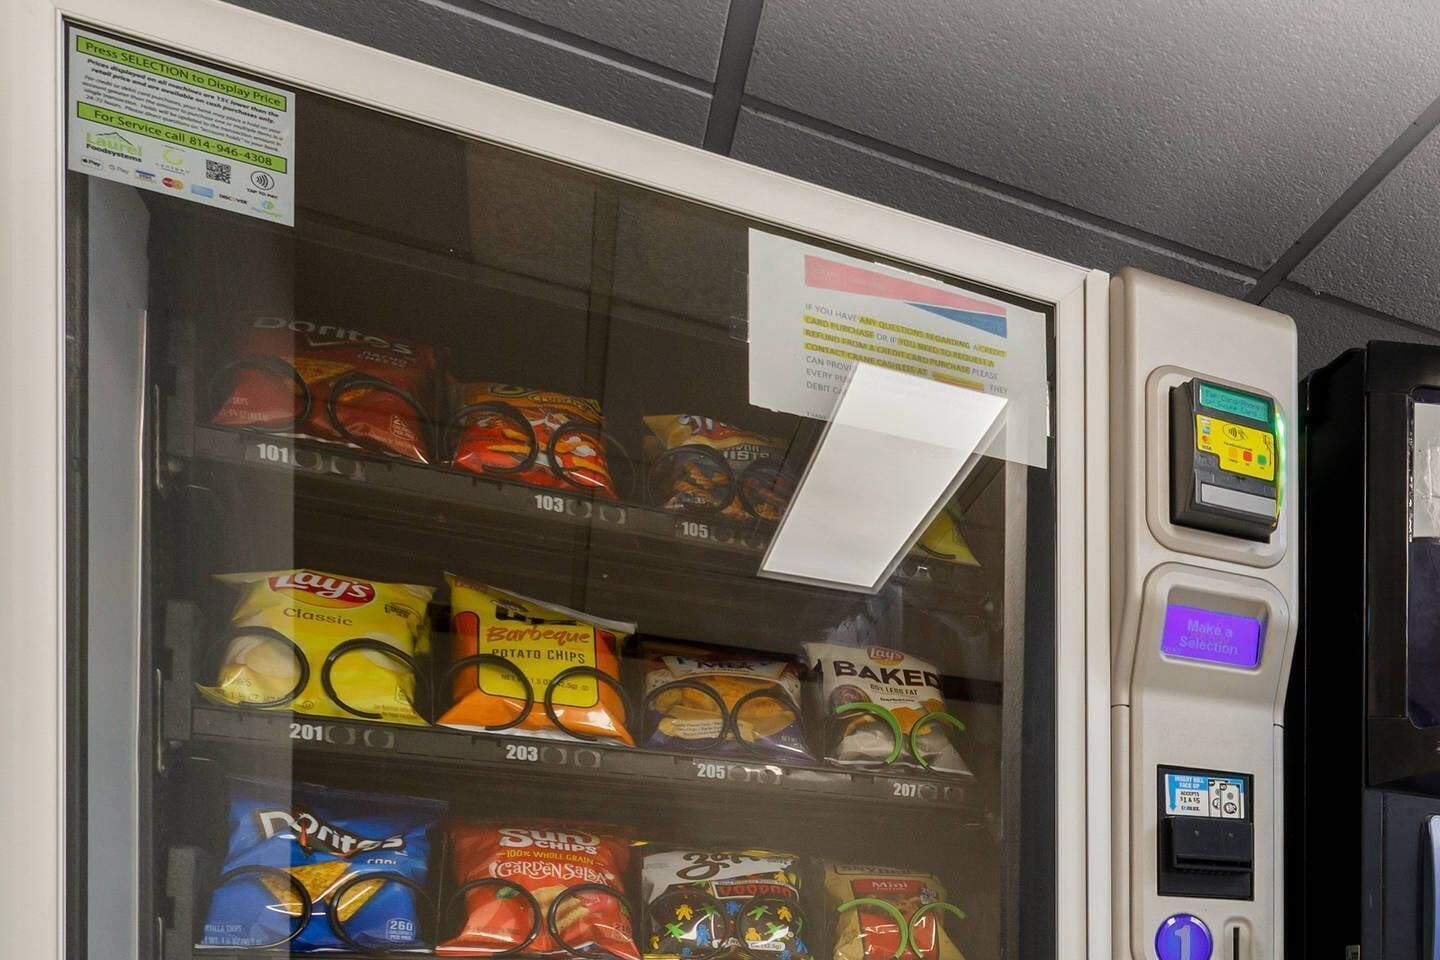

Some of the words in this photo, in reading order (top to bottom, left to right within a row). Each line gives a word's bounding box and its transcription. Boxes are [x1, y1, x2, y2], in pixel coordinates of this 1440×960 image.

[85, 41, 117, 59] Press
[121, 51, 188, 79] SELECTION
[192, 72, 203, 84] to
[207, 77, 249, 99] Display
[254, 91, 280, 106] Price
[94, 110, 113, 122] For
[117, 116, 161, 135] Service
[164, 129, 184, 141] call
[189, 136, 272, 165] 814-946-4308
[86, 144, 142, 162] Foodsystems
[253, 316, 413, 355] Doritos
[806, 355, 824, 366] CAN
[806, 368, 832, 379] EVERY
[806, 381, 829, 393] DEBIT
[256, 443, 290, 464] 101
[535, 495, 564, 513] 103
[682, 521, 708, 538] 105
[274, 571, 375, 600] Lay's
[283, 607, 353, 626] Classic
[486, 625, 591, 646] Barbeque
[1187, 619, 1221, 635] Make
[1225, 628, 1233, 639] a
[1178, 635, 1238, 655] Selection
[492, 648, 541, 660] POTATO
[547, 649, 585, 664] CHIPS
[834, 659, 943, 690] BAKED
[290, 723, 323, 741] 201
[506, 745, 538, 762] 203
[697, 765, 726, 779] 205
[894, 783, 916, 797] 207
[259, 808, 404, 856] Doritos
[499, 828, 600, 849] Sun
[536, 840, 598, 855] CHIPS
[505, 849, 531, 859] 100%
[533, 850, 565, 861] WHOLE
[566, 854, 595, 865] GRAIN
[871, 880, 908, 889] Mini
[390, 919, 413, 931] 260
